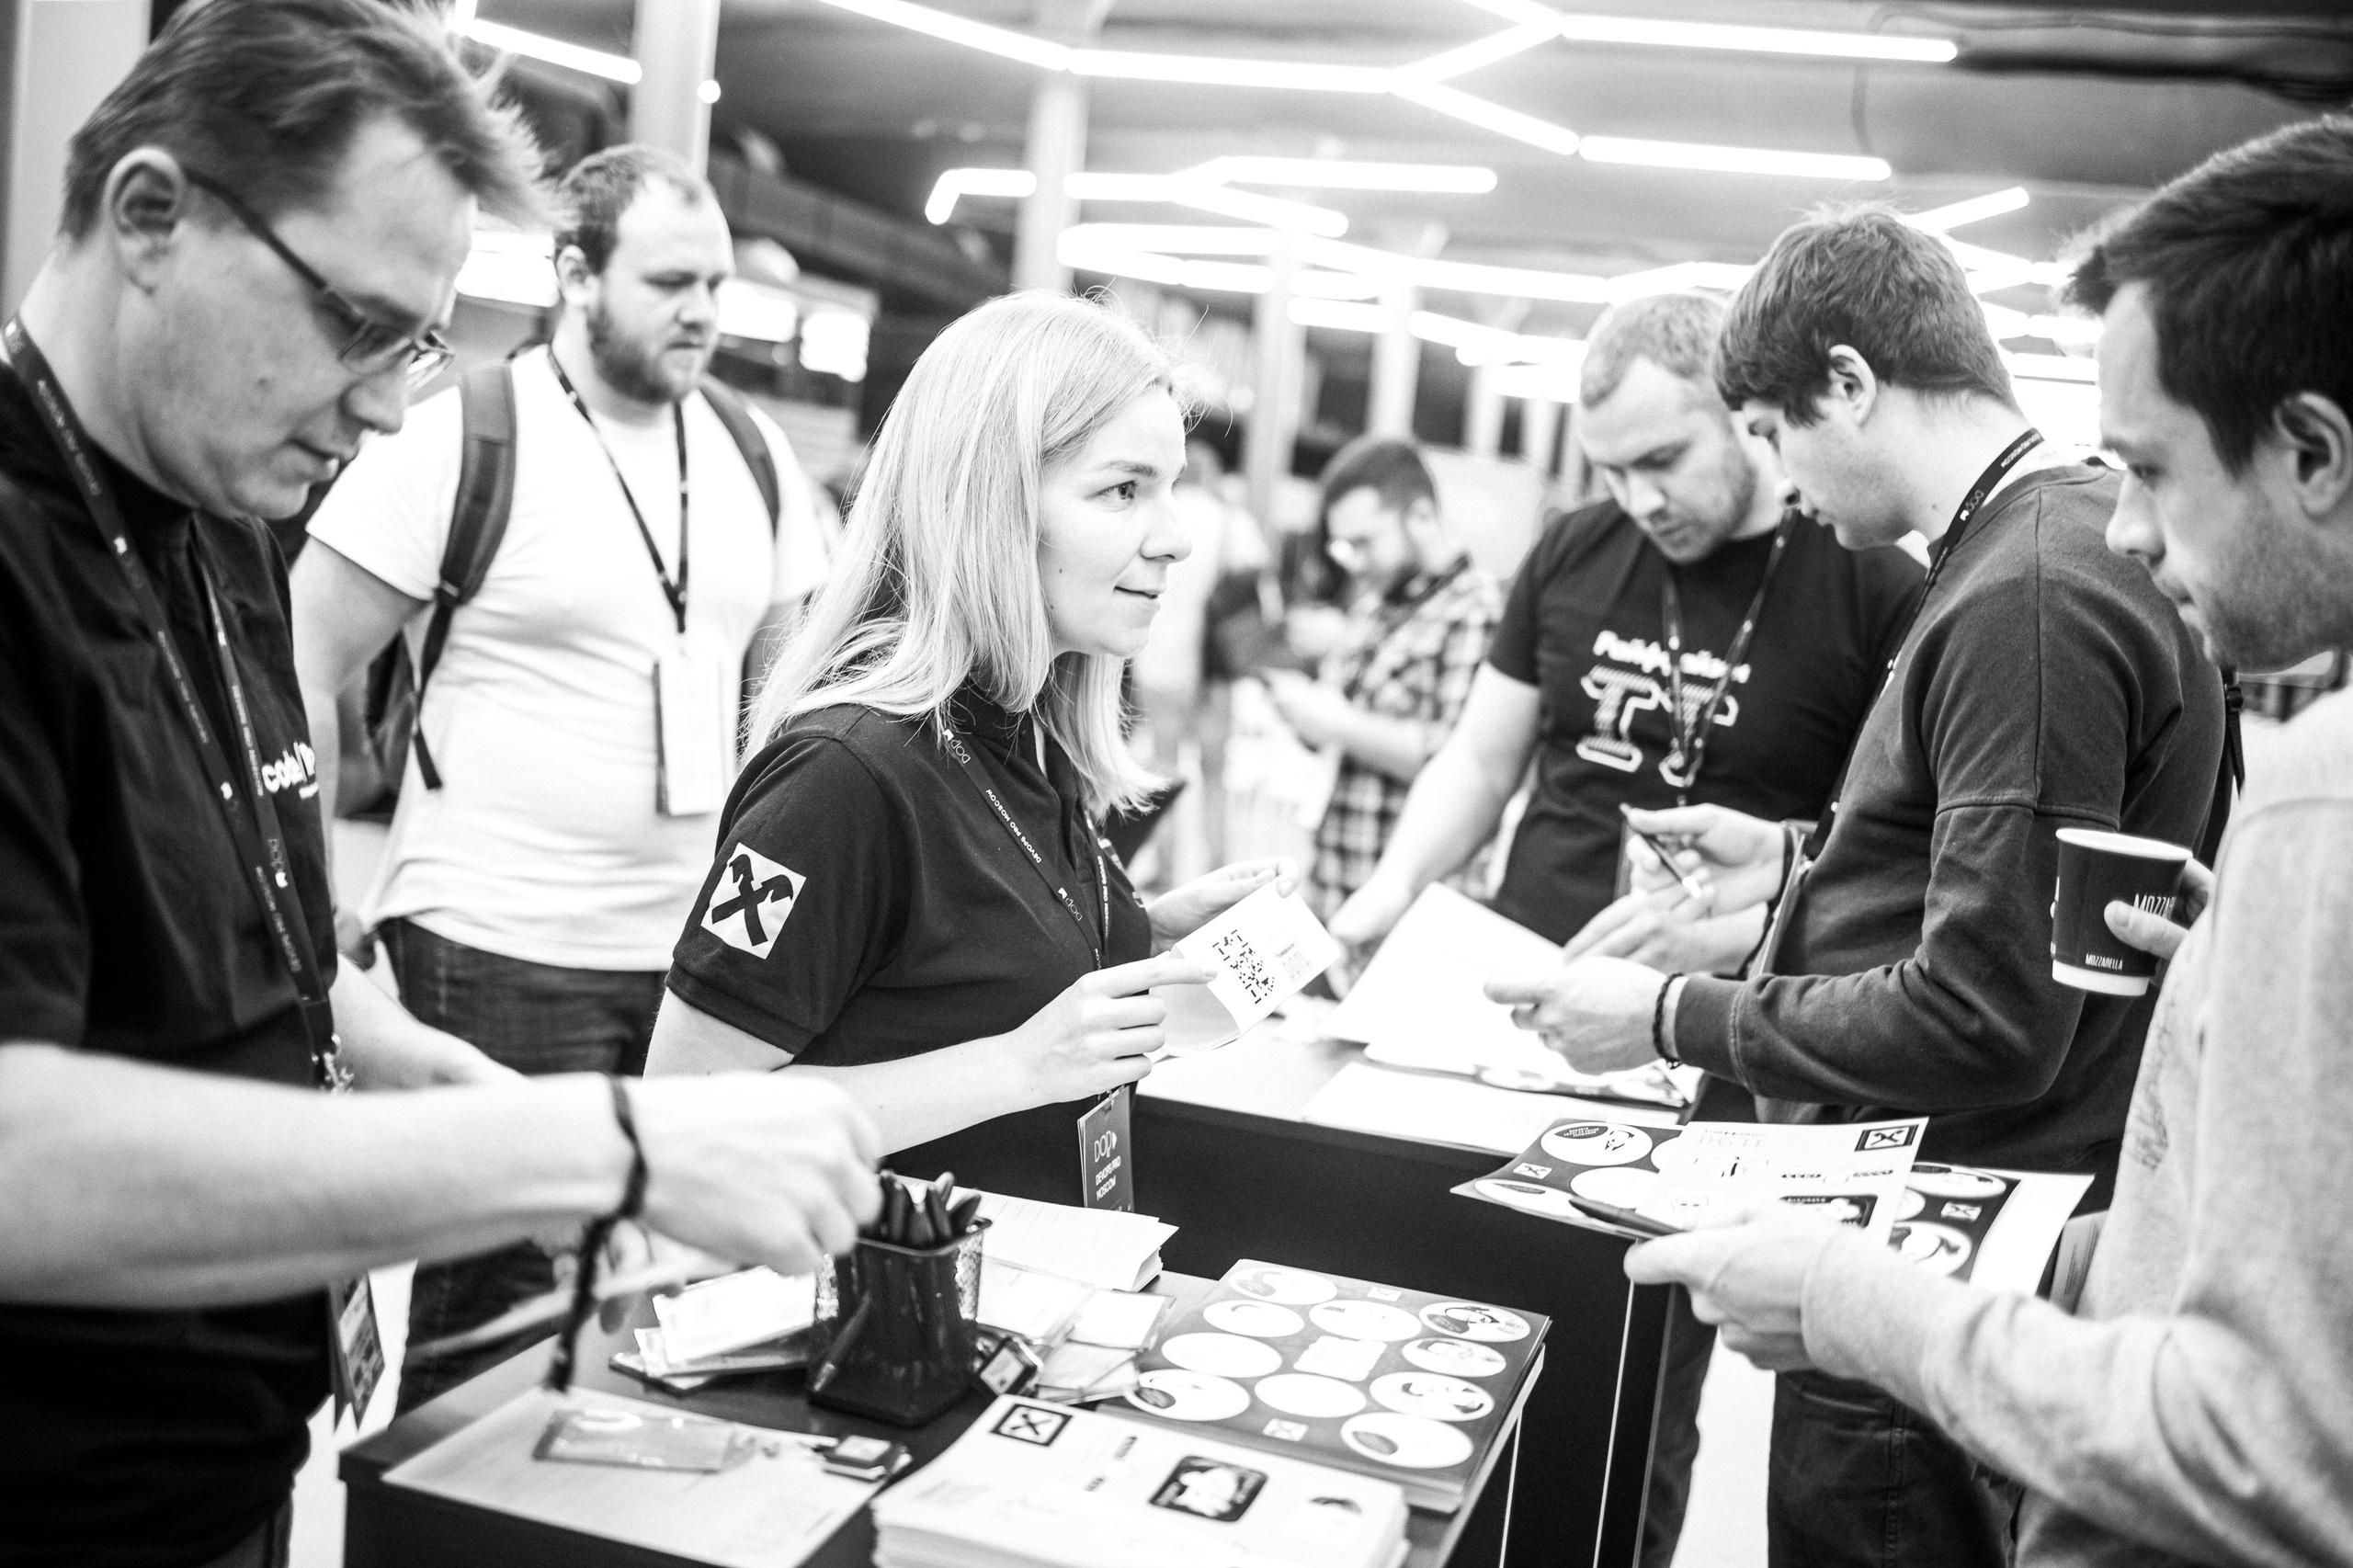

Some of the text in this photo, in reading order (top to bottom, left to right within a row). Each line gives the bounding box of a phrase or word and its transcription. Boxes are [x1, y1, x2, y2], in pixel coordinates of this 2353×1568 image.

[985, 789, 1041, 864] DEVOPS PRO MOSCOW
[2086, 953, 2122, 970] MOZZARELLA
